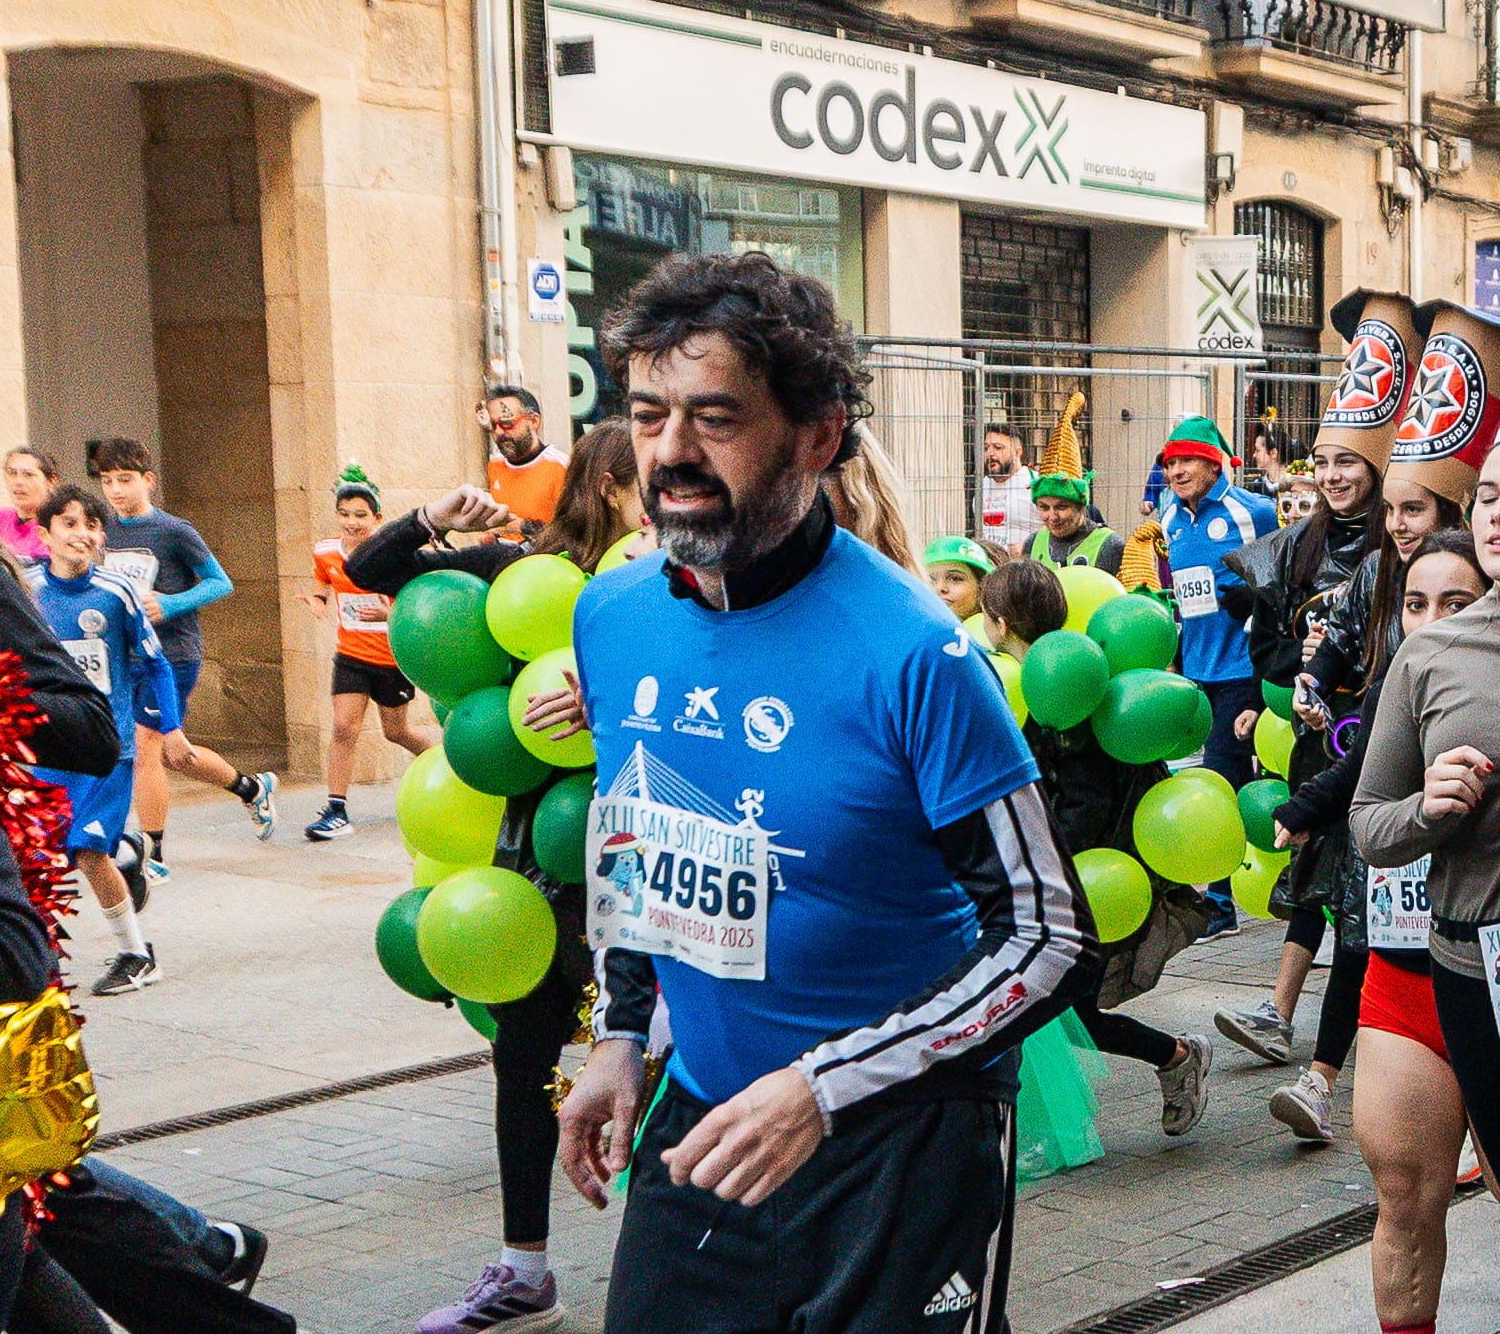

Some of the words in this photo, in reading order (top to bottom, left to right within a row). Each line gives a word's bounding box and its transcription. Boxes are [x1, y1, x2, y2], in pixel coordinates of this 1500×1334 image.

[770, 37, 899, 76] encuadernaciones
[1083, 160, 1125, 180] imprenta
[1127, 167, 1157, 186] digital
[1197, 330, 1256, 350] códex
[1338, 410, 1377, 422] DESDE
[1377, 396, 1396, 417] 1906
[1433, 421, 1469, 451] DESDE
[1466, 390, 1480, 423] 1906
[1182, 579, 1211, 599] 2593
[640, 809, 670, 846] SAN
[676, 818, 757, 867] SILVESTRE
[650, 851, 758, 921] 4956
[1400, 880, 1431, 912] 58
[647, 906, 717, 946] PONTEVEDRA
[719, 925, 756, 949] 2025
